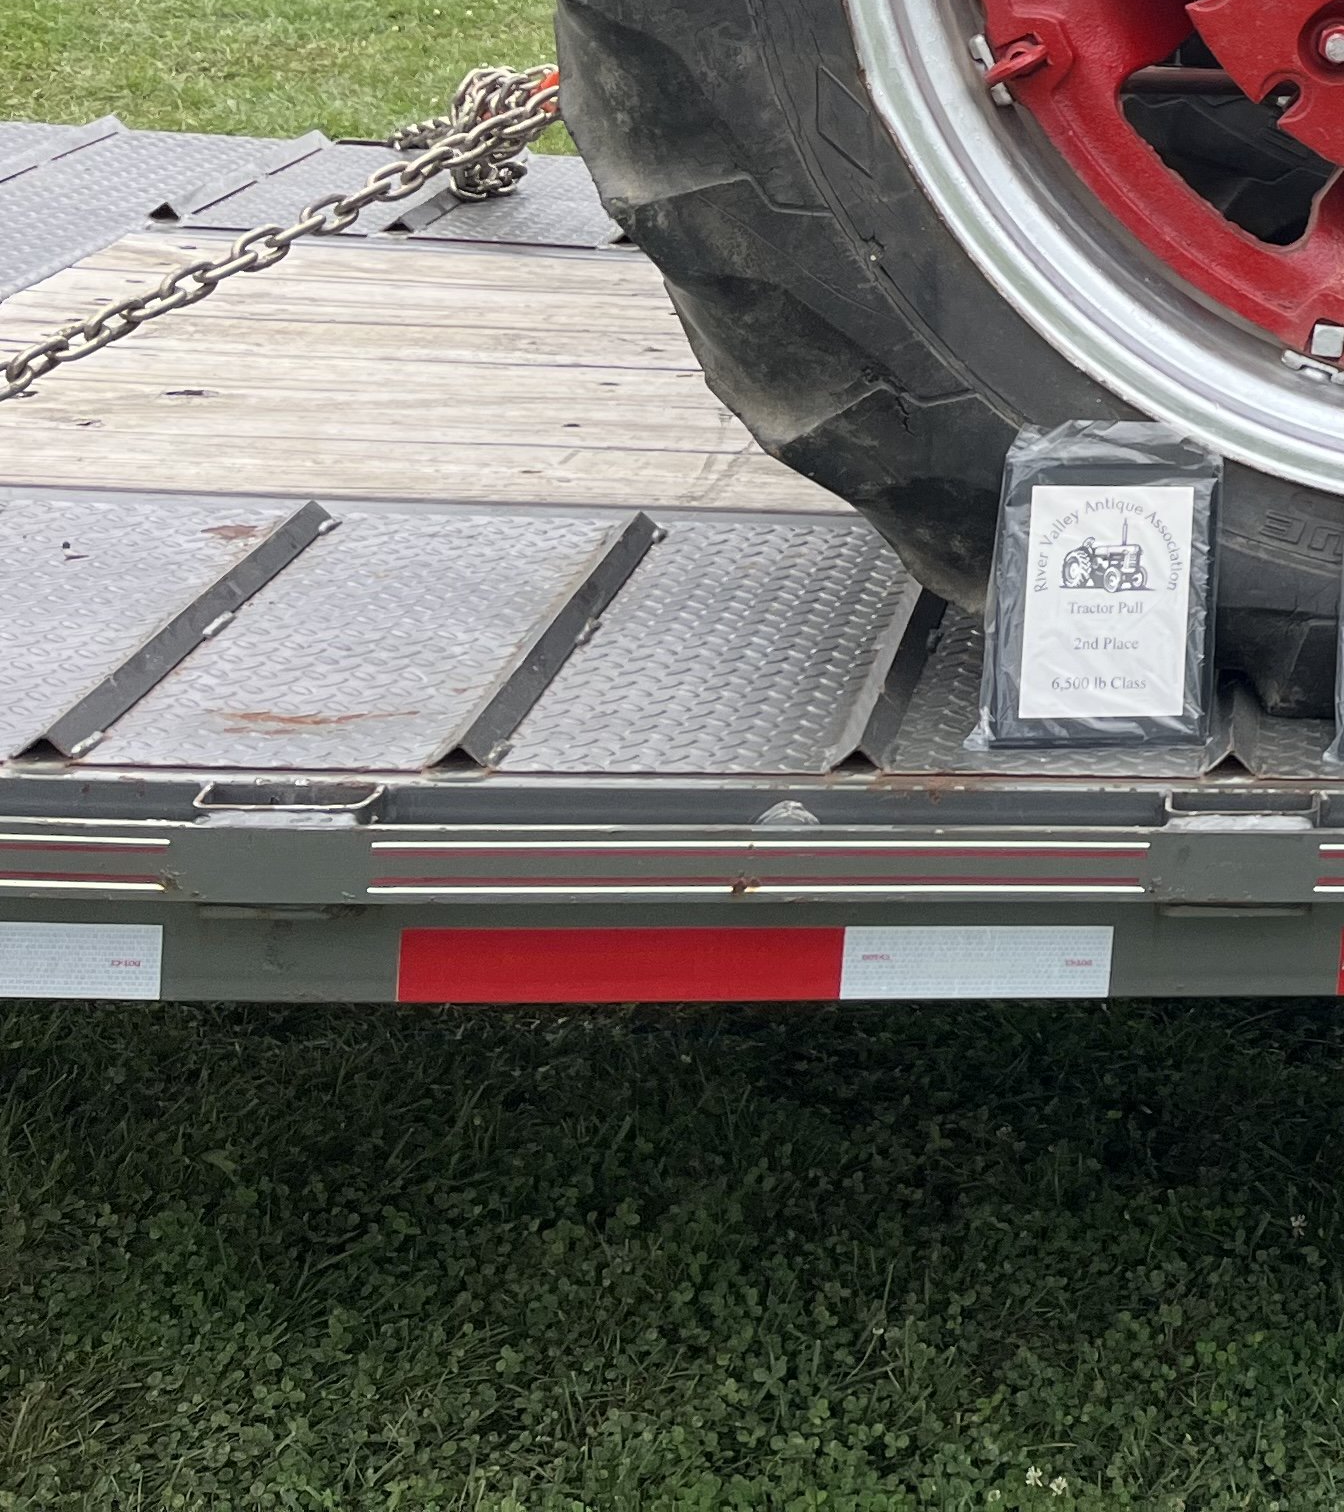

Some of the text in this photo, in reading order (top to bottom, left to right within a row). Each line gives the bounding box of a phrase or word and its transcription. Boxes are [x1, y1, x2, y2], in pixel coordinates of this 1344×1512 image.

[1033, 497, 1185, 593] River Valley Antique Association
[1068, 601, 1144, 615] Tractor Pull
[1073, 637, 1139, 650] 2nd Place
[1051, 676, 1147, 691] 6,500 lb Class
